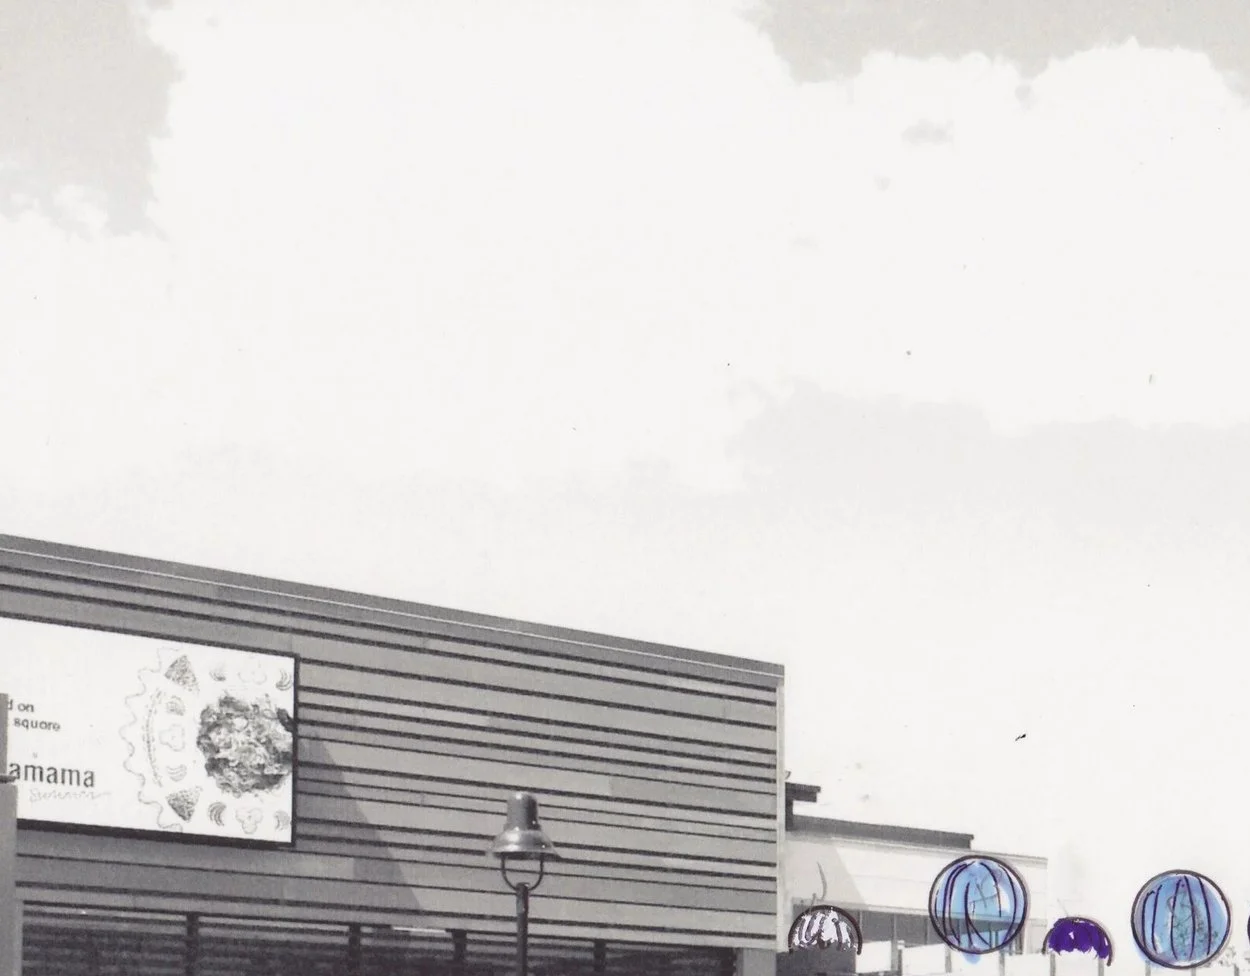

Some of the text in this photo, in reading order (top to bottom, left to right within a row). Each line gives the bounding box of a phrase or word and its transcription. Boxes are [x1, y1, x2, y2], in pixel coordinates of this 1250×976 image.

[17, 703, 34, 713] on
[14, 717, 61, 732] square
[9, 762, 95, 788] amama
